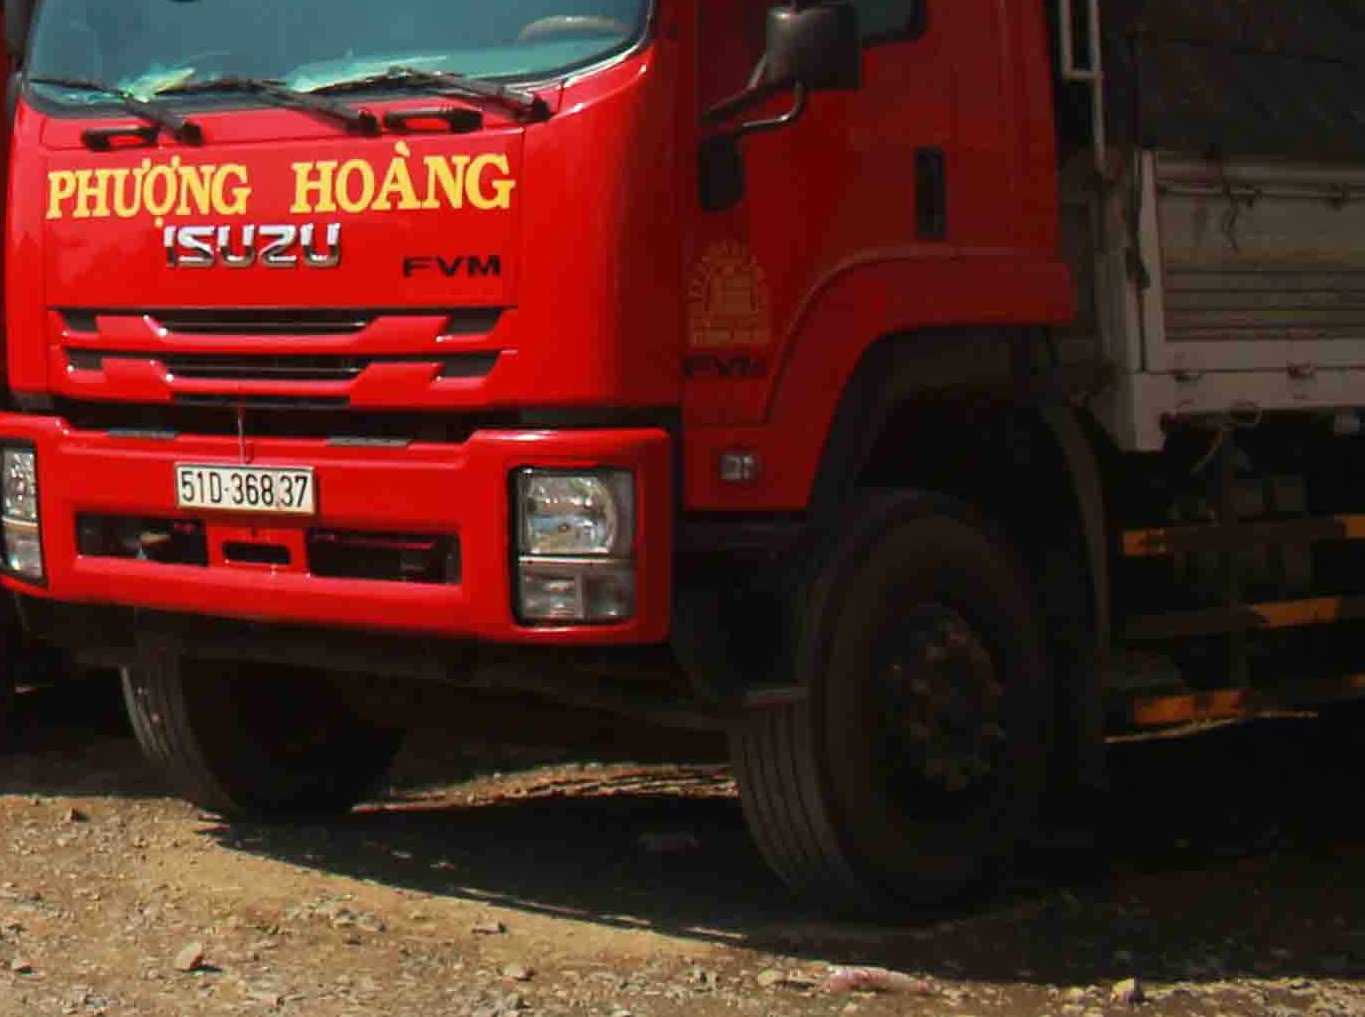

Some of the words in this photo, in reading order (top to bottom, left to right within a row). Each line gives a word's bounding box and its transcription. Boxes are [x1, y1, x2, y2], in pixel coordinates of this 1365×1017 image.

[45, 156, 251, 228] PHƯỢNG
[289, 141, 516, 214] HOÀNG
[162, 222, 342, 269] ISUZU
[401, 254, 501, 279] FVM
